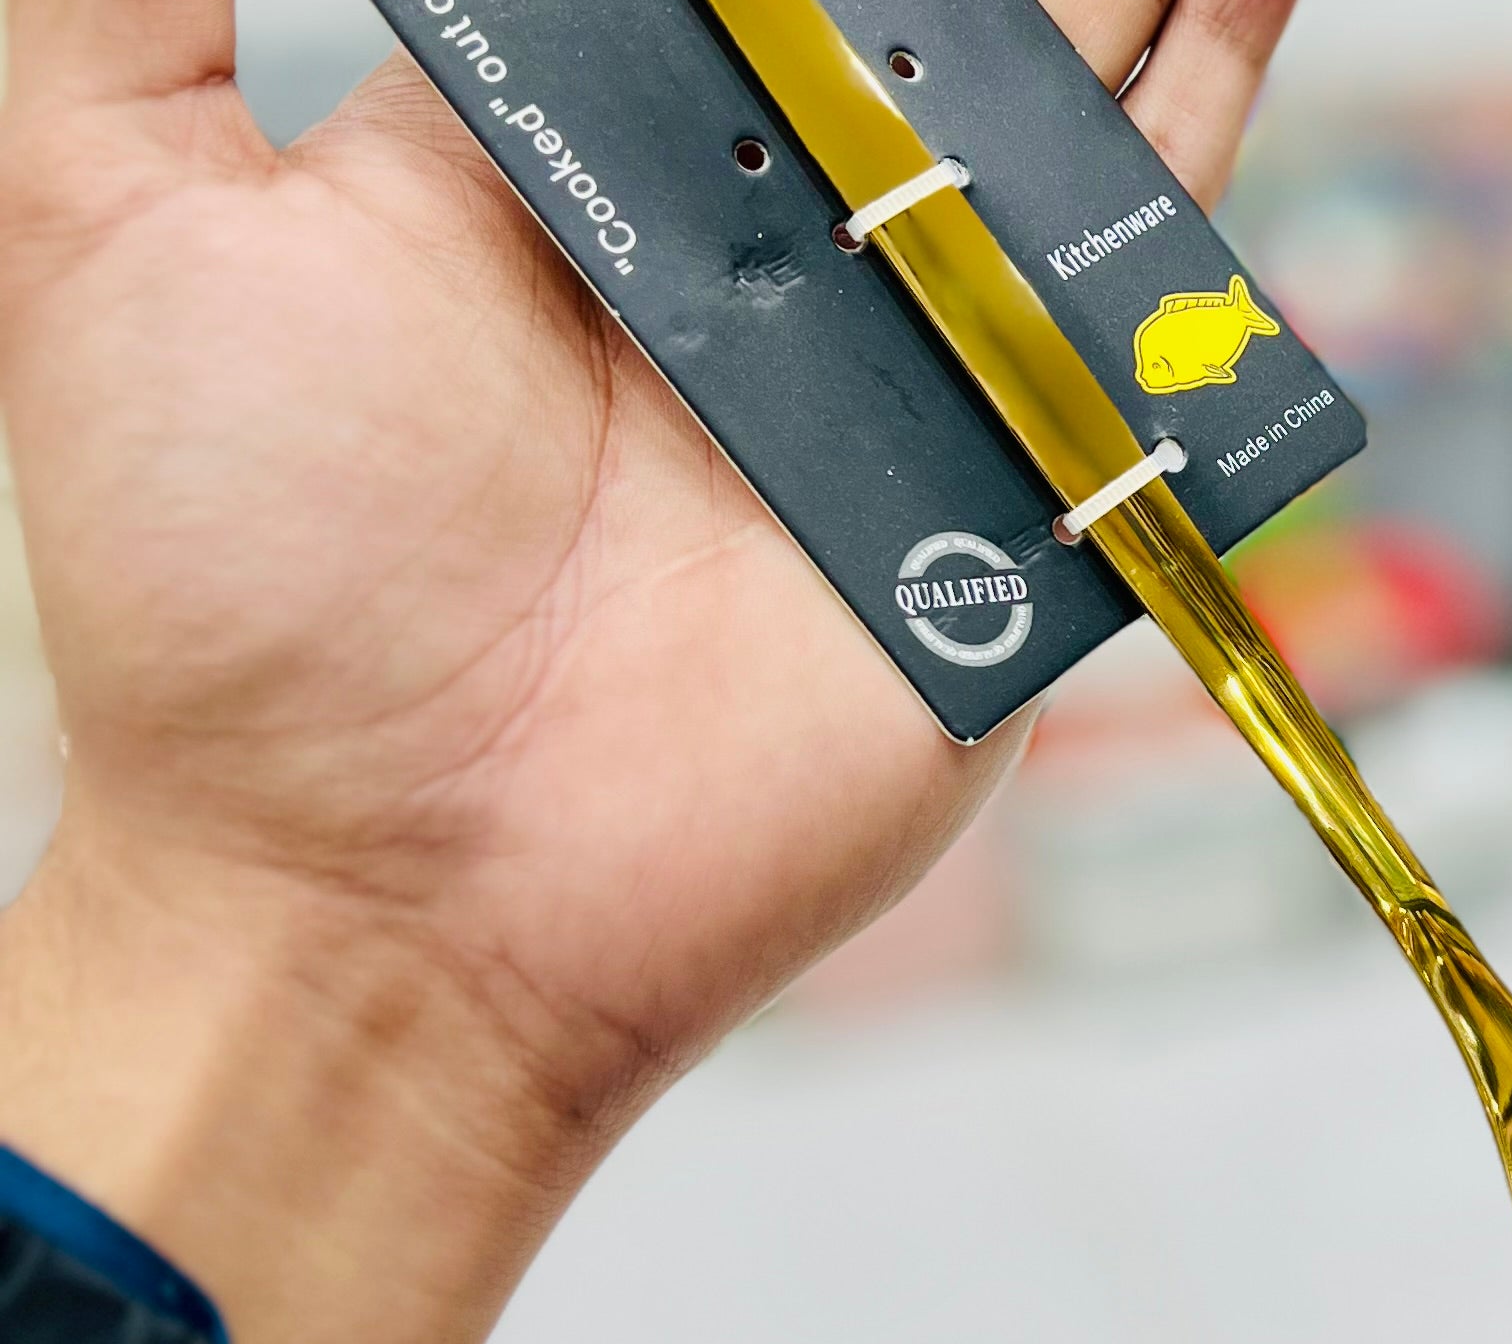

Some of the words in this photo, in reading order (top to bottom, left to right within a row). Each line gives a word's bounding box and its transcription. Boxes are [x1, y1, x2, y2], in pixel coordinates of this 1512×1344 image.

[440, 14, 508, 83] out
[1046, 194, 1177, 281] Kitchenware
[1216, 432, 1270, 478] Made
[1264, 421, 1288, 444] in
[1282, 388, 1335, 429] China
[894, 573, 1028, 617] QUALIFIED
